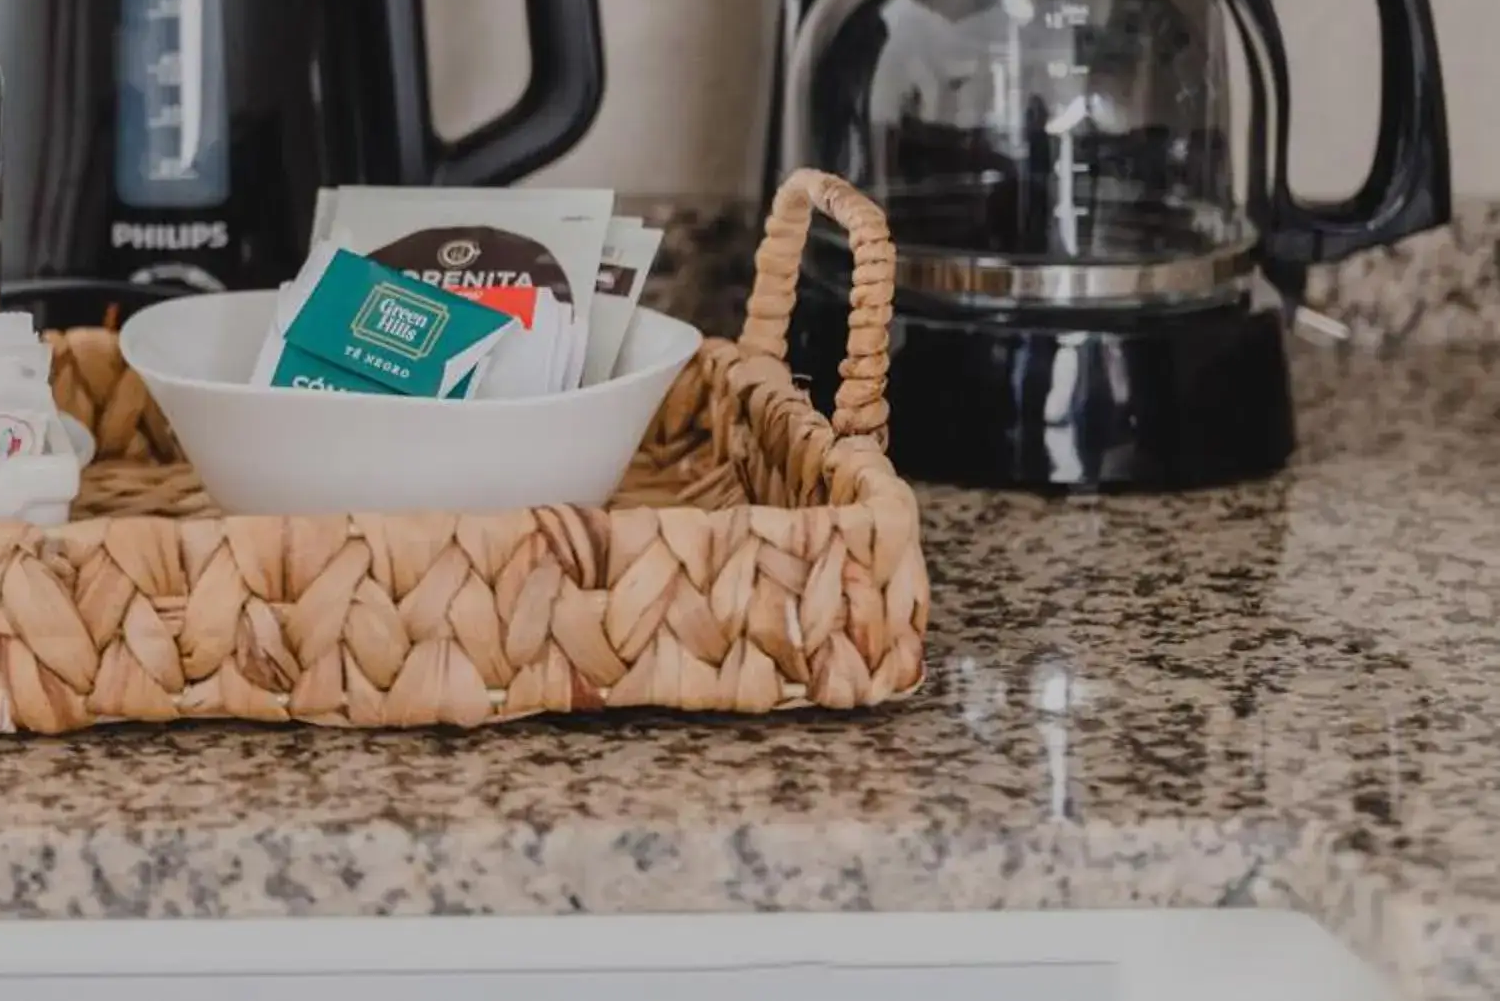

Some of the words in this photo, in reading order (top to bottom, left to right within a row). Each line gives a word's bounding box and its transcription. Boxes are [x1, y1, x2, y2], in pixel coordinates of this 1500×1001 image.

[111, 221, 229, 249] PHILIPS
[379, 298, 428, 328] Green
[376, 314, 417, 341] Hills
